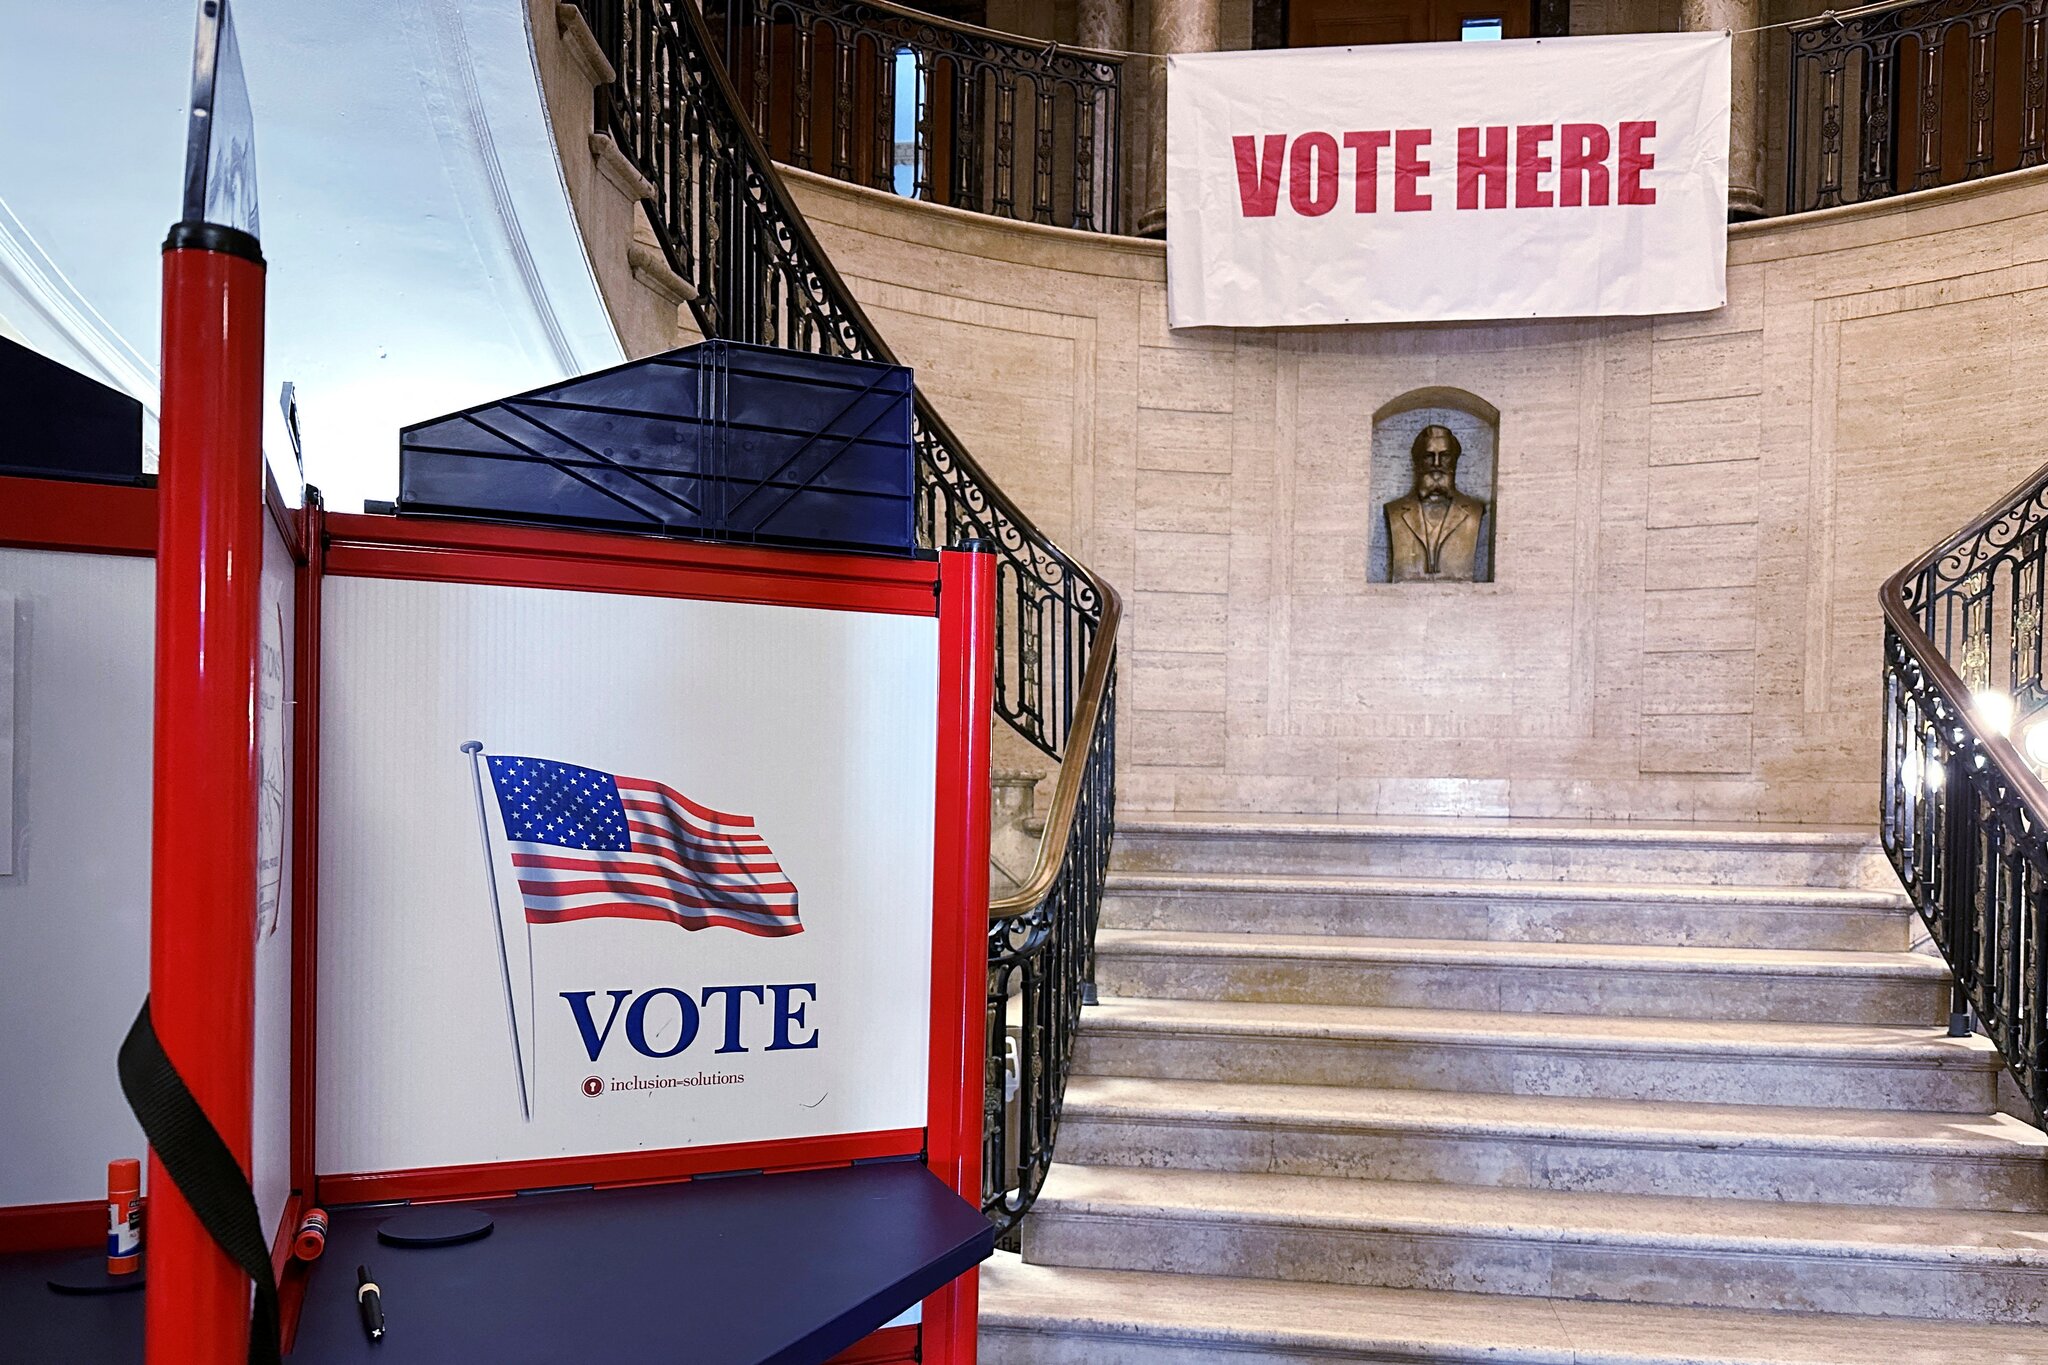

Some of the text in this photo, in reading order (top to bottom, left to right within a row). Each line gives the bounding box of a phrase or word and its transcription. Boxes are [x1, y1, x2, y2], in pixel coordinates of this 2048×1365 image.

[1232, 121, 1656, 217] VOTE HERE
[559, 983, 819, 1062] VOTE
